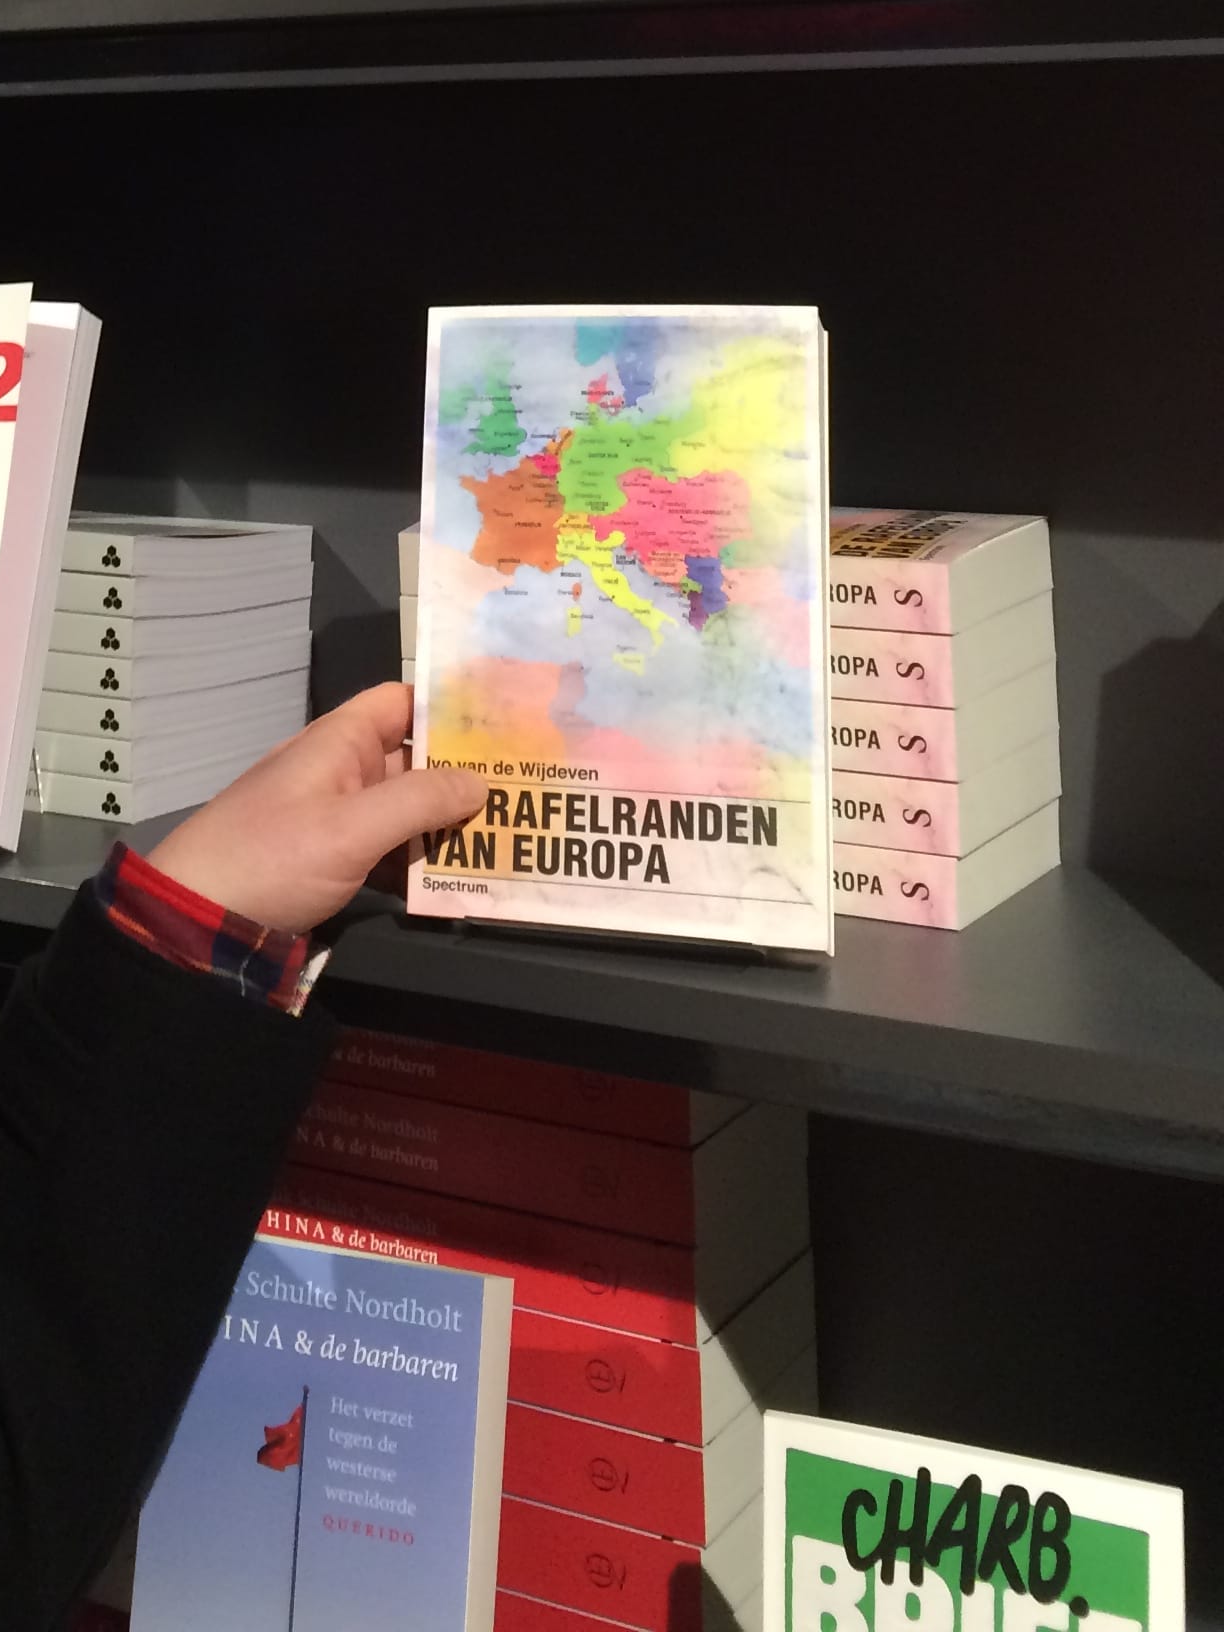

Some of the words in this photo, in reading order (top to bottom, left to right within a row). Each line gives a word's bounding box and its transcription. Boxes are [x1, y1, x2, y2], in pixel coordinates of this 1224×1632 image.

[457, 758, 488, 775] van
[492, 759, 516, 776] de
[519, 761, 599, 782] Wijdeven
[484, 787, 778, 847] RAFELRANDEN
[832, 797, 886, 824] ROPA
[421, 830, 496, 870] VAN
[511, 833, 671, 885] EUROPA
[421, 876, 489, 895] Spectrum
[331, 1225, 345, 1245] &
[348, 1229, 367, 1249] de
[369, 1232, 439, 1266] barbaren
[245, 1270, 339, 1311] Schulte
[344, 1287, 464, 1334] Nordholt
[293, 1329, 313, 1357] &
[319, 1333, 348, 1362] de
[352, 1338, 460, 1383] barbaren
[329, 1395, 360, 1418] Het
[363, 1404, 415, 1429] verzet
[328, 1426, 374, 1450] tegen
[377, 1434, 399, 1455] de
[326, 1455, 398, 1484] westerse
[324, 1484, 417, 1517] wereldorde
[322, 1514, 415, 1547] QUERIDO
[841, 1466, 1090, 1620] CHARB.
